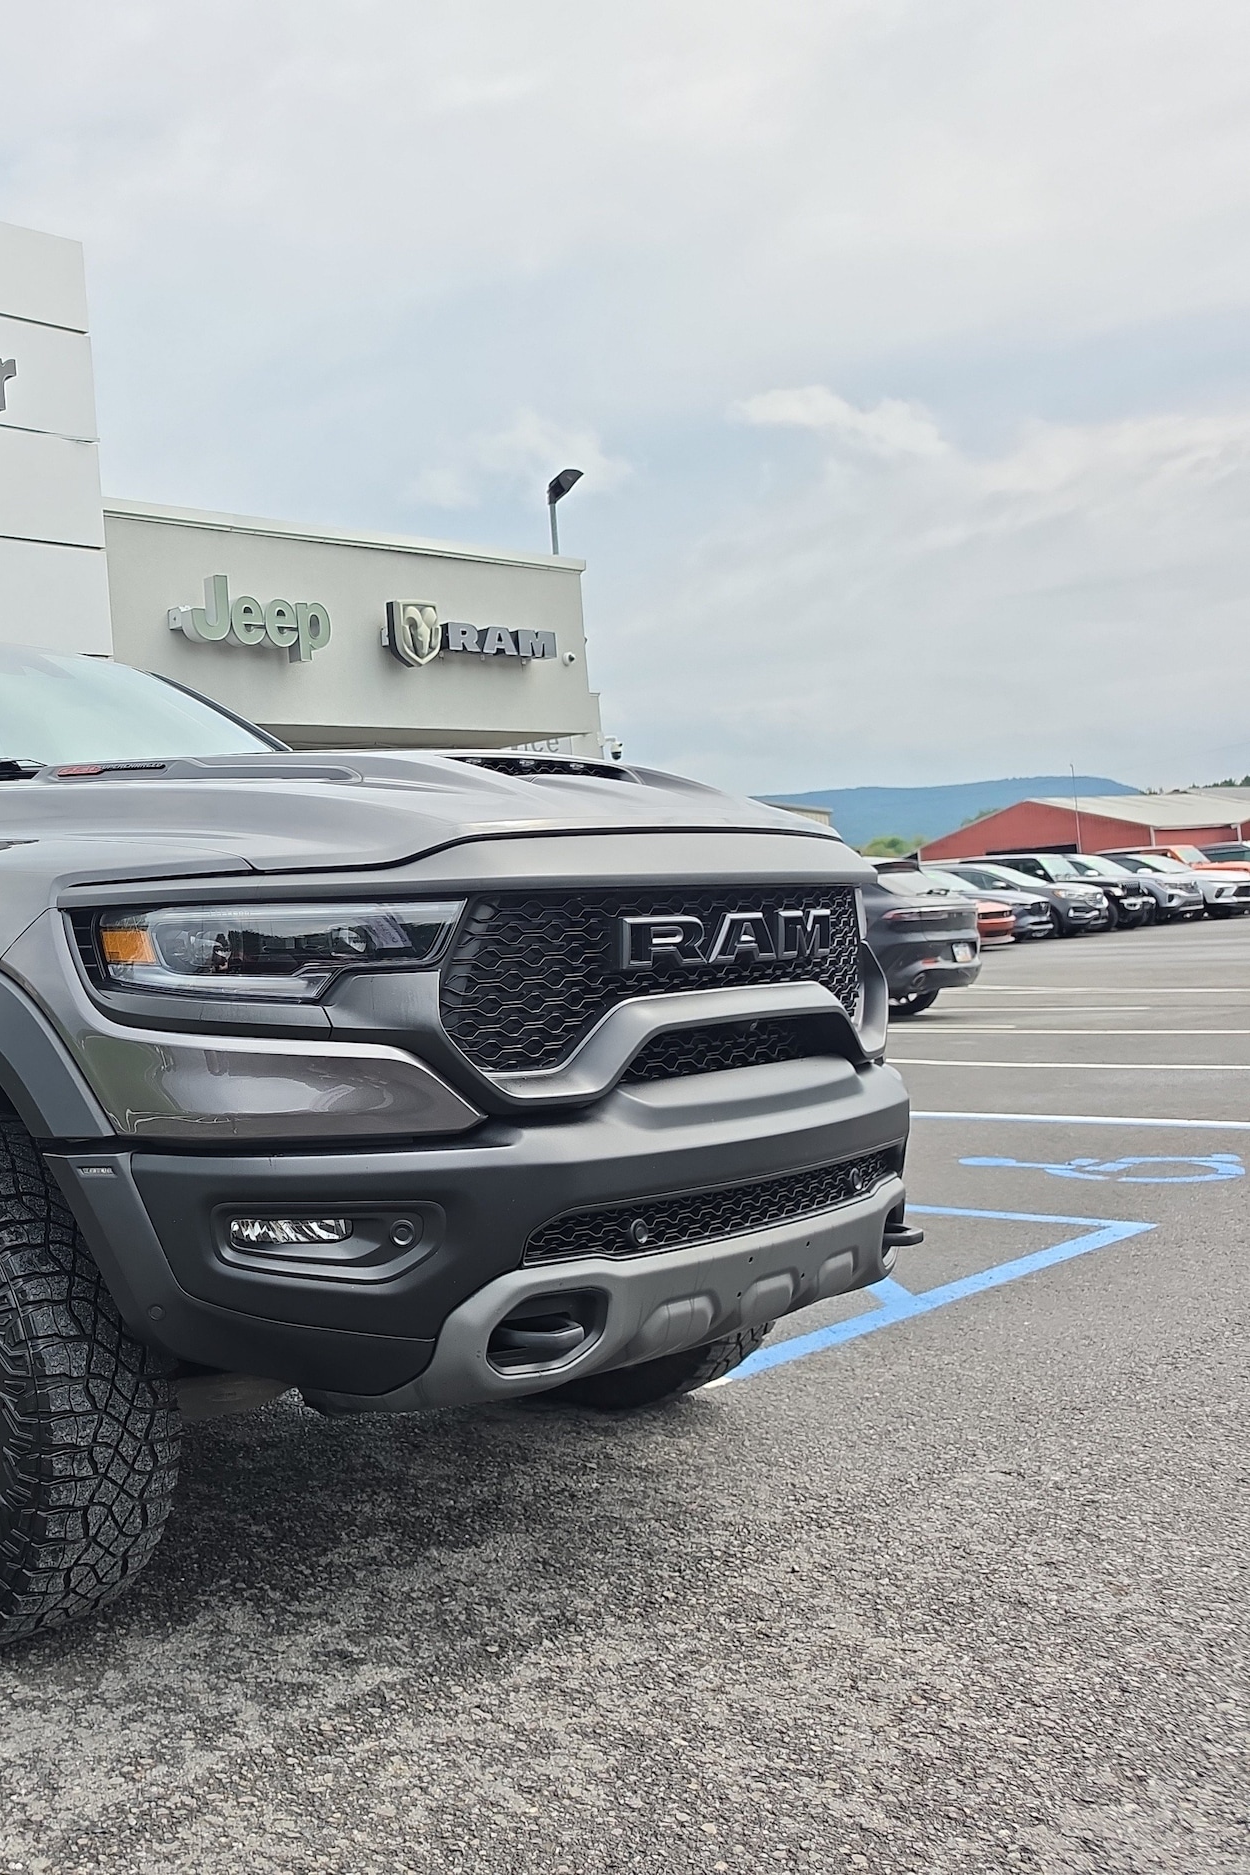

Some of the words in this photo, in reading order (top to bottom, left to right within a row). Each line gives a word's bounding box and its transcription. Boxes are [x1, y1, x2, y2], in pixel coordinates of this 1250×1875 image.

[181, 573, 332, 663] Jeep
[447, 621, 558, 660] RAM
[619, 908, 832, 970] RAM
